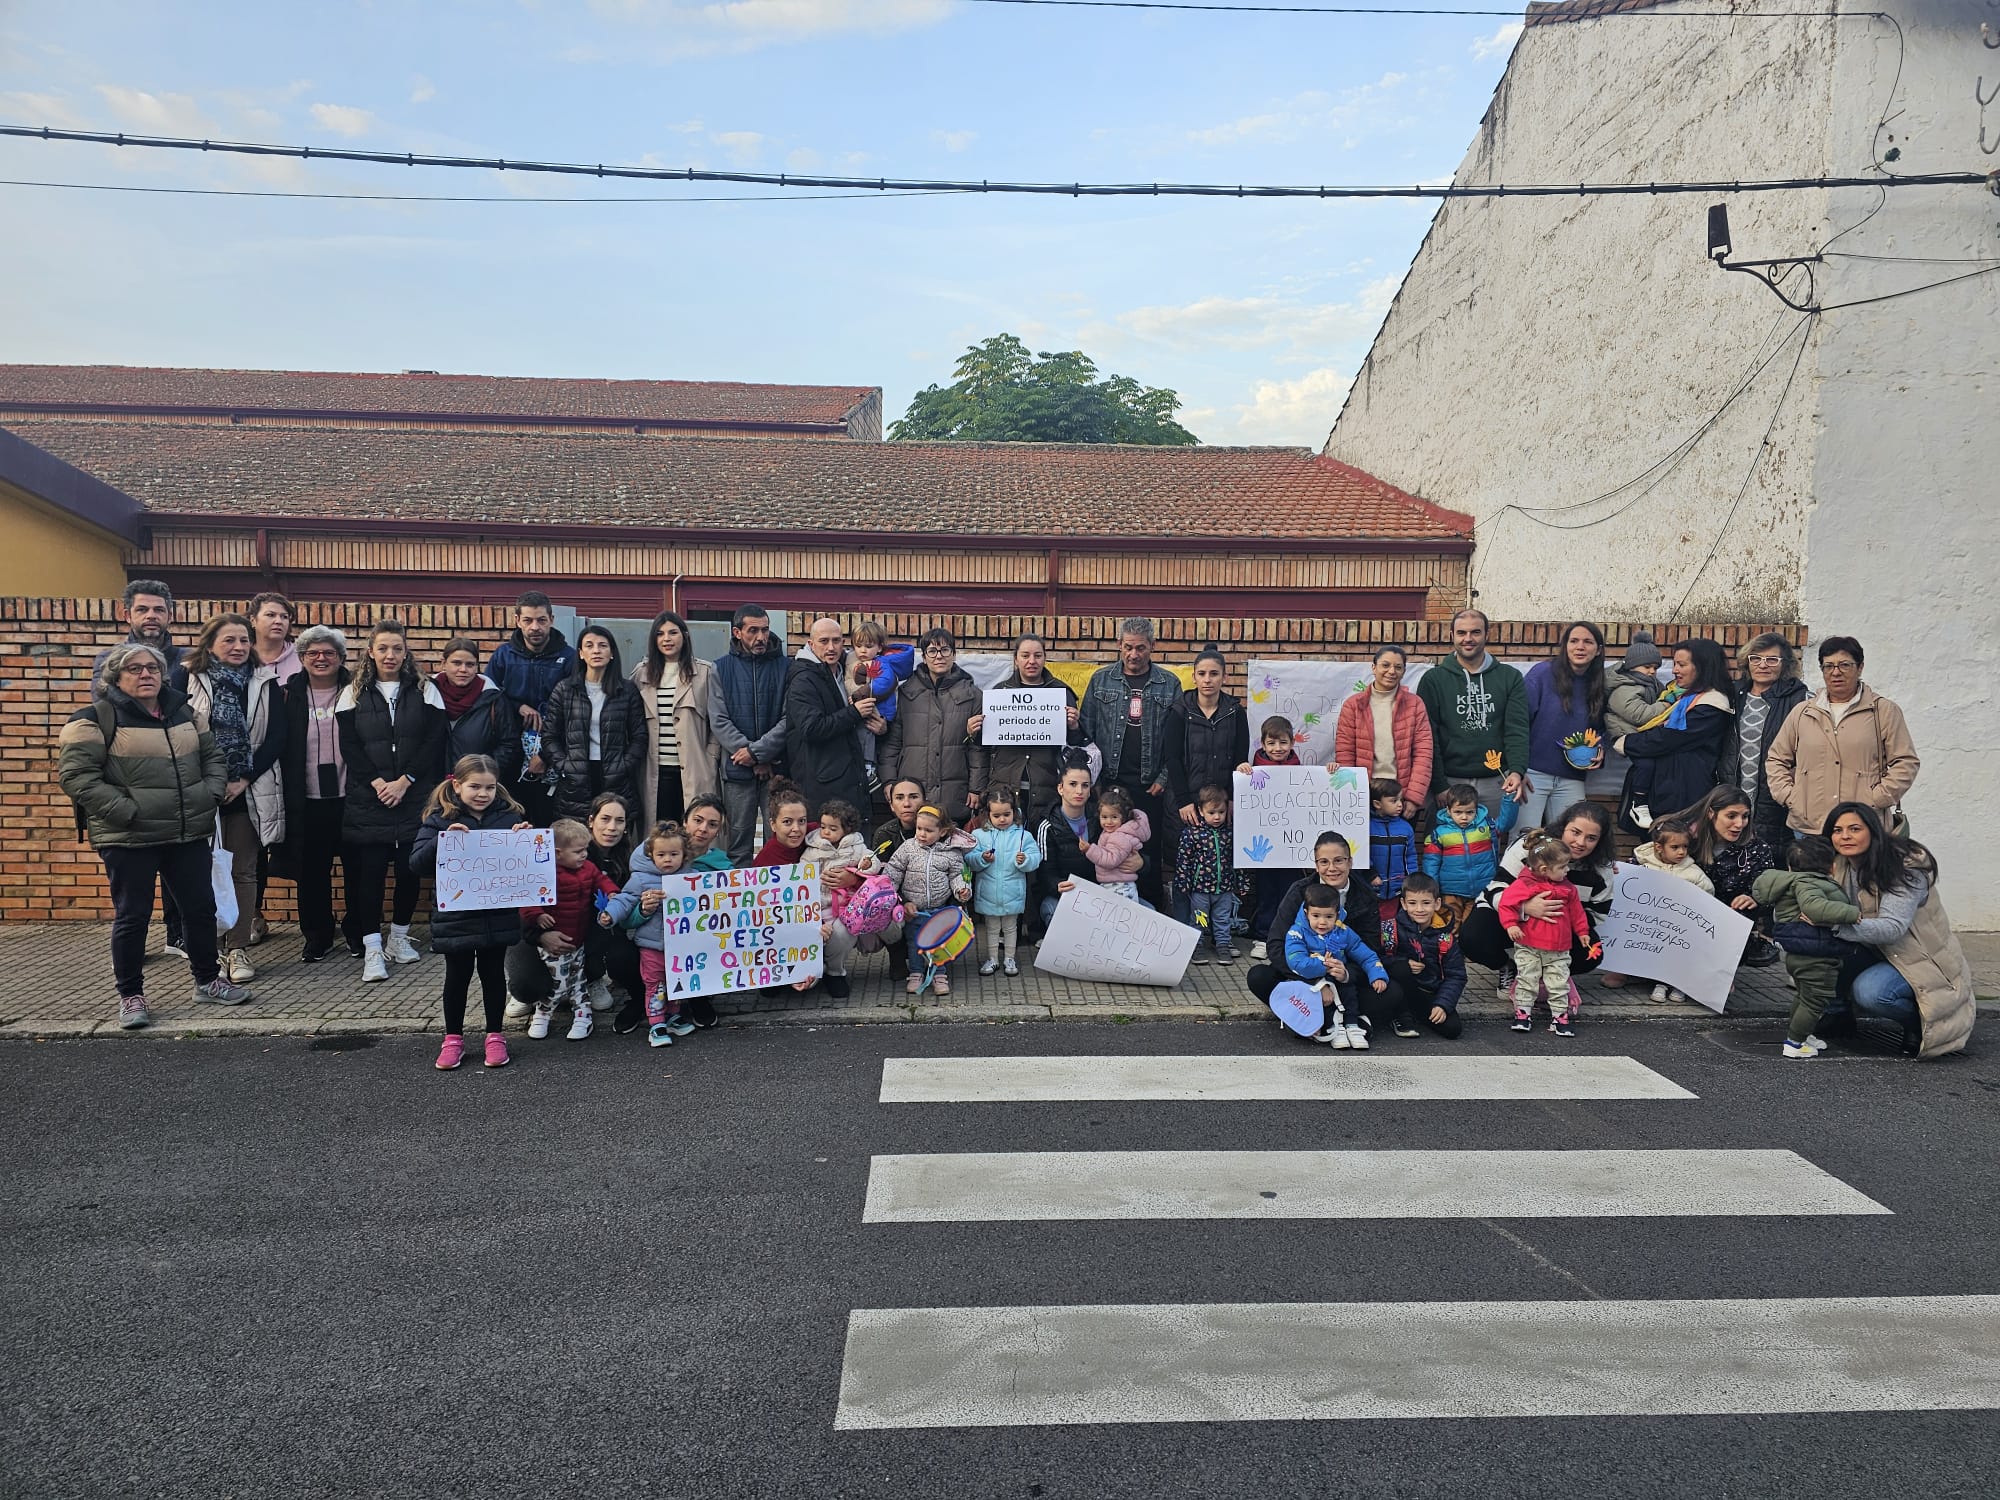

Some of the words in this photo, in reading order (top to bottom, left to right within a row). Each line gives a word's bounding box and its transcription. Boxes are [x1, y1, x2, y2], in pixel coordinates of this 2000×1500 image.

[1012, 693, 1033, 704] NO
[1456, 693, 1492, 704] KEEP
[989, 703, 1038, 713] queremos
[1040, 703, 1060, 712] otro
[1456, 702, 1495, 714] CALM
[999, 716, 1037, 727] periodo
[1039, 716, 1051, 725] de
[998, 732, 1052, 743] adaptación
[1288, 770, 1315, 786] LA
[1240, 787, 1341, 810] EDUCACIÓN
[1349, 791, 1367, 808] DE
[1259, 810, 1291, 827] L@S
[1308, 809, 1366, 826] NIÑ@S
[445, 833, 466, 852] EN
[479, 831, 532, 849] ESTA
[1283, 829, 1305, 844] NO
[446, 853, 529, 873] OCASIÓN
[1287, 846, 1316, 863] TOC
[439, 877, 459, 892] NO
[468, 873, 548, 893] QUEREMOS
[683, 865, 781, 892] TENEMOS
[789, 863, 816, 882] LA
[477, 889, 536, 905] JUGAR
[666, 884, 810, 916] ADAPTACION
[665, 915, 691, 936] YA
[695, 911, 732, 933] CON
[736, 901, 821, 929] NUESTRAS
[1607, 908, 1623, 919] DE
[712, 925, 776, 950] TEIS
[1624, 922, 1692, 951] SUSPENSO
[1088, 927, 1118, 950] EN
[1121, 941, 1150, 967] EL
[671, 951, 708, 974] LAS
[720, 944, 819, 970] QUEREMOS
